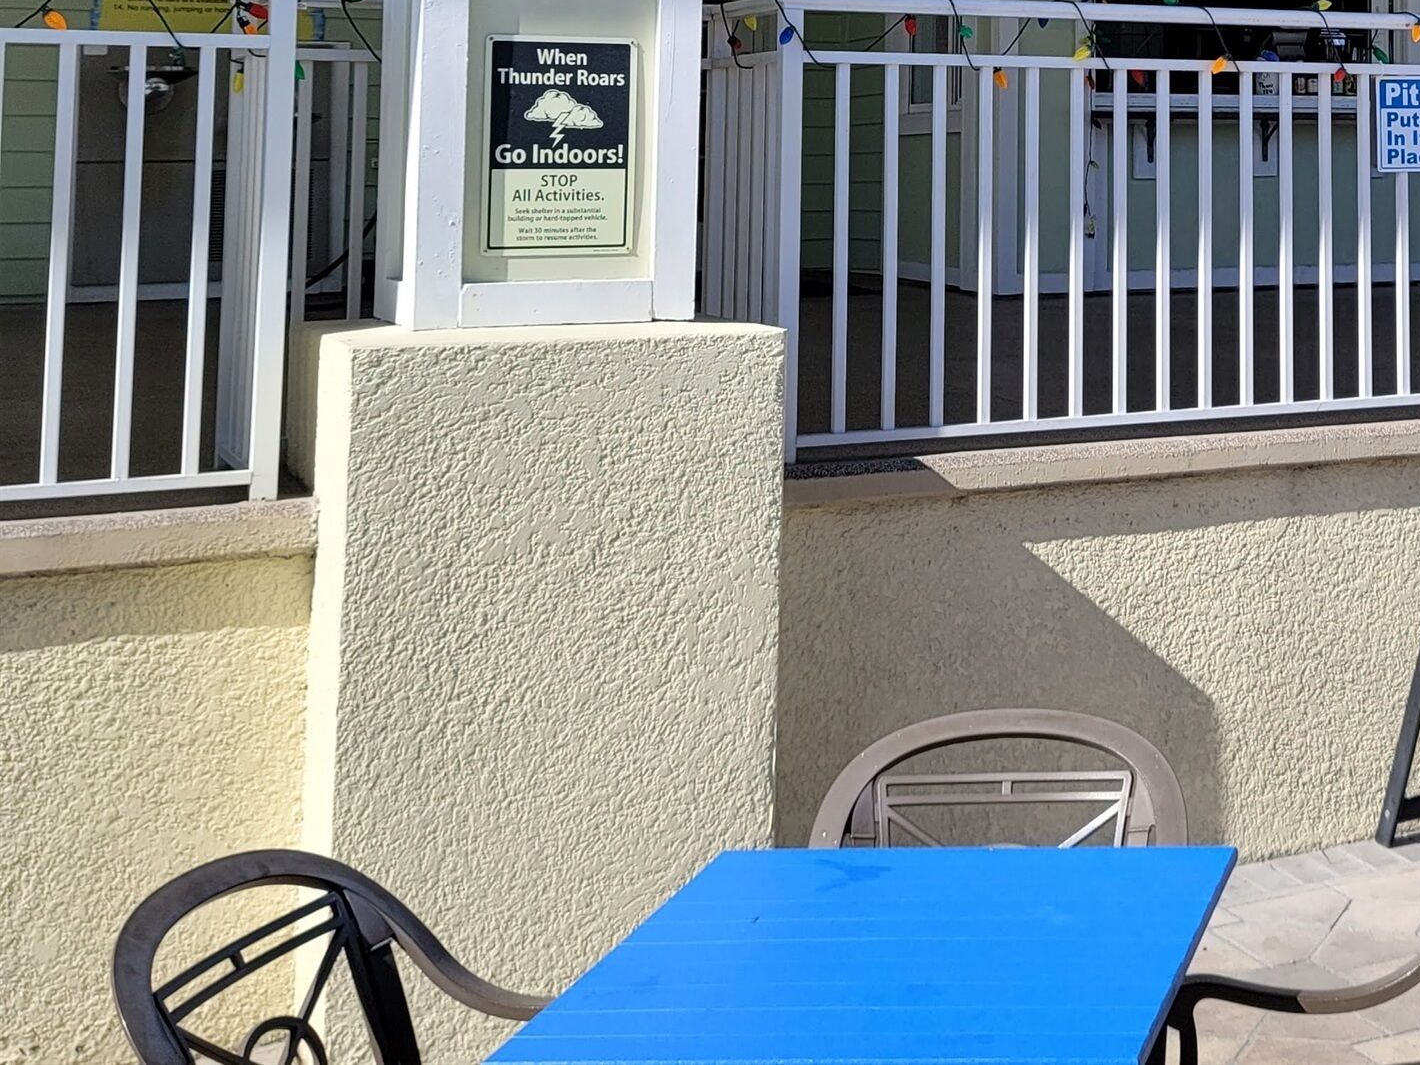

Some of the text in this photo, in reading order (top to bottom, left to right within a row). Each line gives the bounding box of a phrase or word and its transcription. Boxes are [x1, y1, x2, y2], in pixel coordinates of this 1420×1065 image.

[537, 48, 587, 65] When
[497, 68, 625, 86] Thunder Roars
[1387, 112, 1419, 127] Put
[1388, 130, 1405, 145] In
[495, 144, 623, 164] Go Indoors!
[541, 175, 577, 187] STOP
[512, 189, 604, 201] All Activities.
